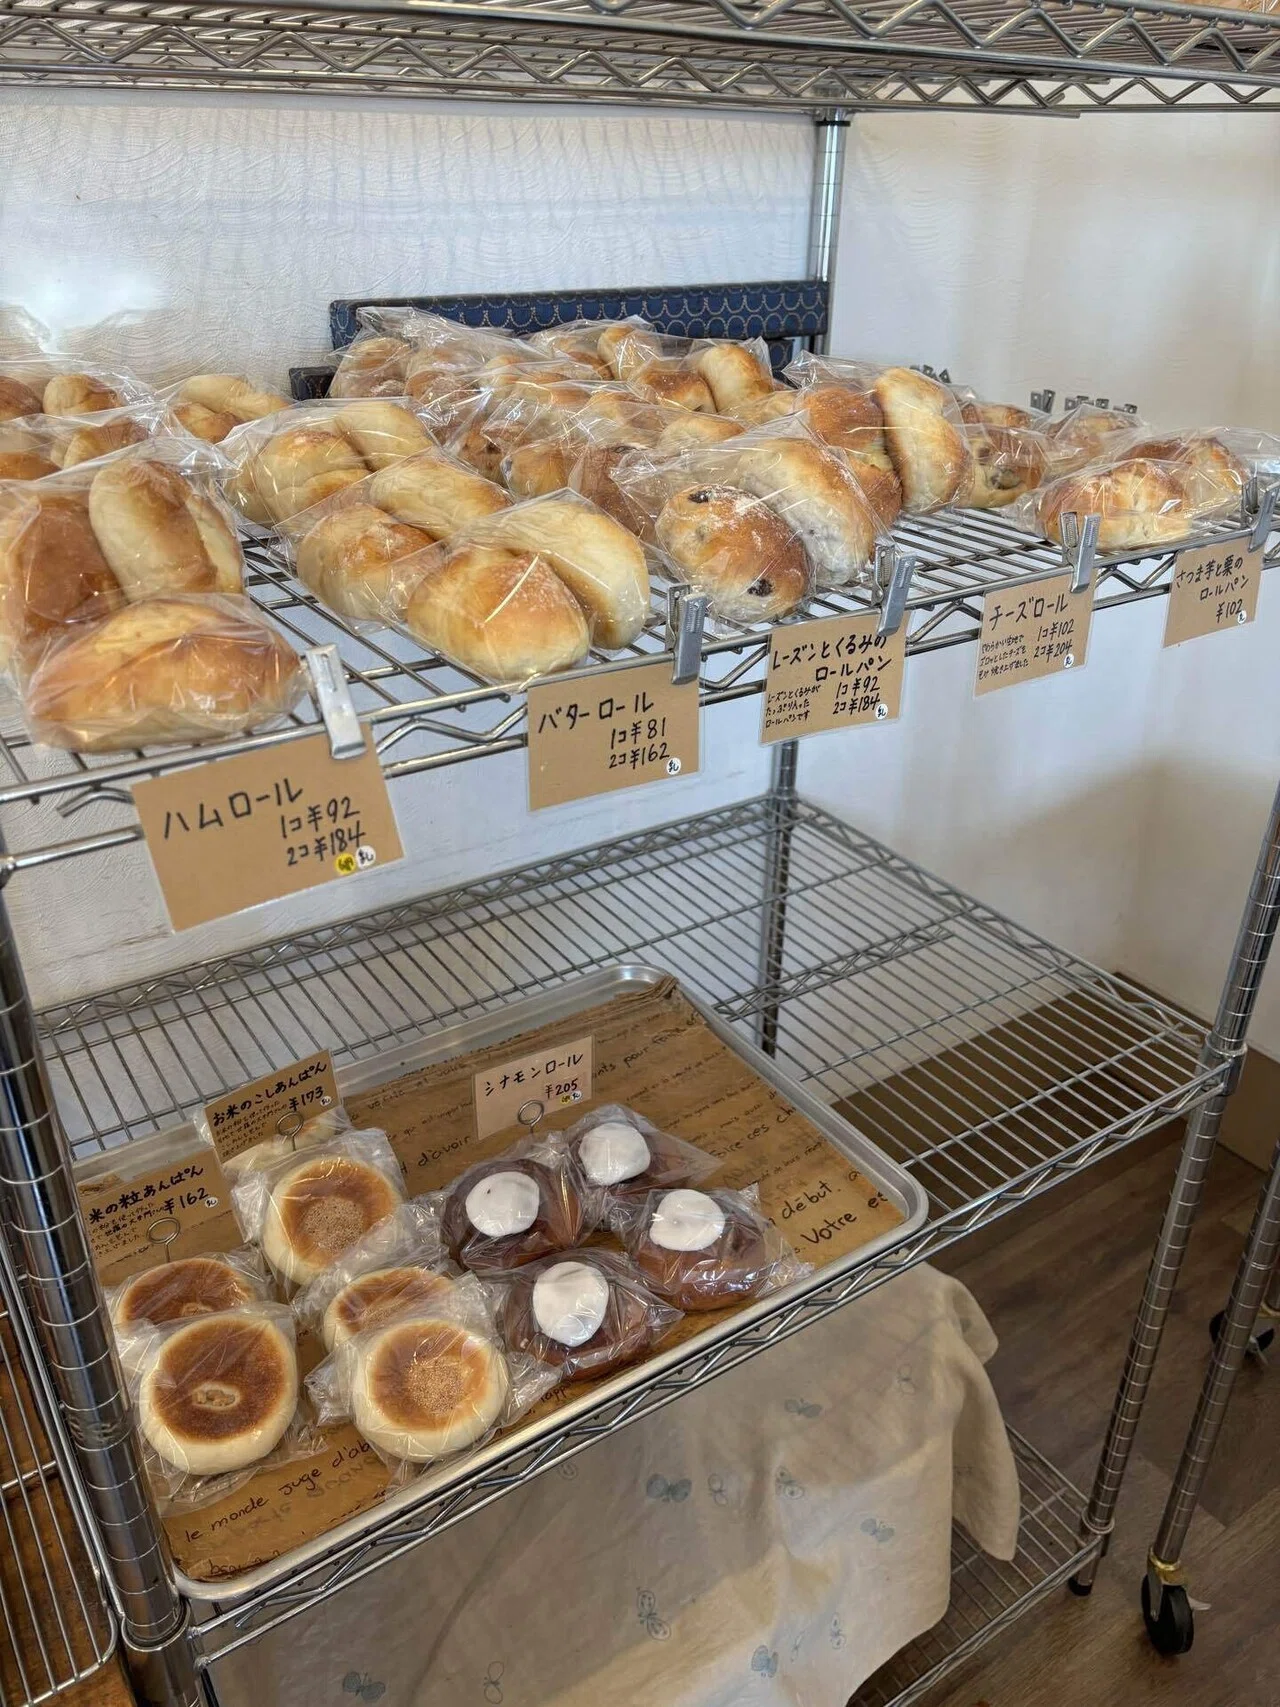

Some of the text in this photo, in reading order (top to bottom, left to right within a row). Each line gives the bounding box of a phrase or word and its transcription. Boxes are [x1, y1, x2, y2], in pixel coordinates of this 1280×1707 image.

[1176, 554, 1244, 589] さつま芋と栗の
[1200, 575, 1249, 601] ロールパン
[989, 594, 1069, 631] チーズロール
[1216, 598, 1243, 624] ¥102
[773, 634, 887, 671] レーズンとくるみの
[816, 655, 893, 682] ロールパン
[538, 691, 655, 733] バターロール
[164, 778, 303, 839] ハムロール
[485, 1053, 584, 1097] シナモンロール
[545, 1077, 579, 1099] ¥205
[213, 1061, 327, 1127] お米のこしあんぱん
[88, 1165, 204, 1225] 米の粒あんぱん
[163, 1187, 209, 1215] ¥162
[800, 1212, 858, 1244] Votre
[185, 1530, 204, 1543] le
[211, 1496, 270, 1531] monde
[278, 1468, 323, 1496] juge
